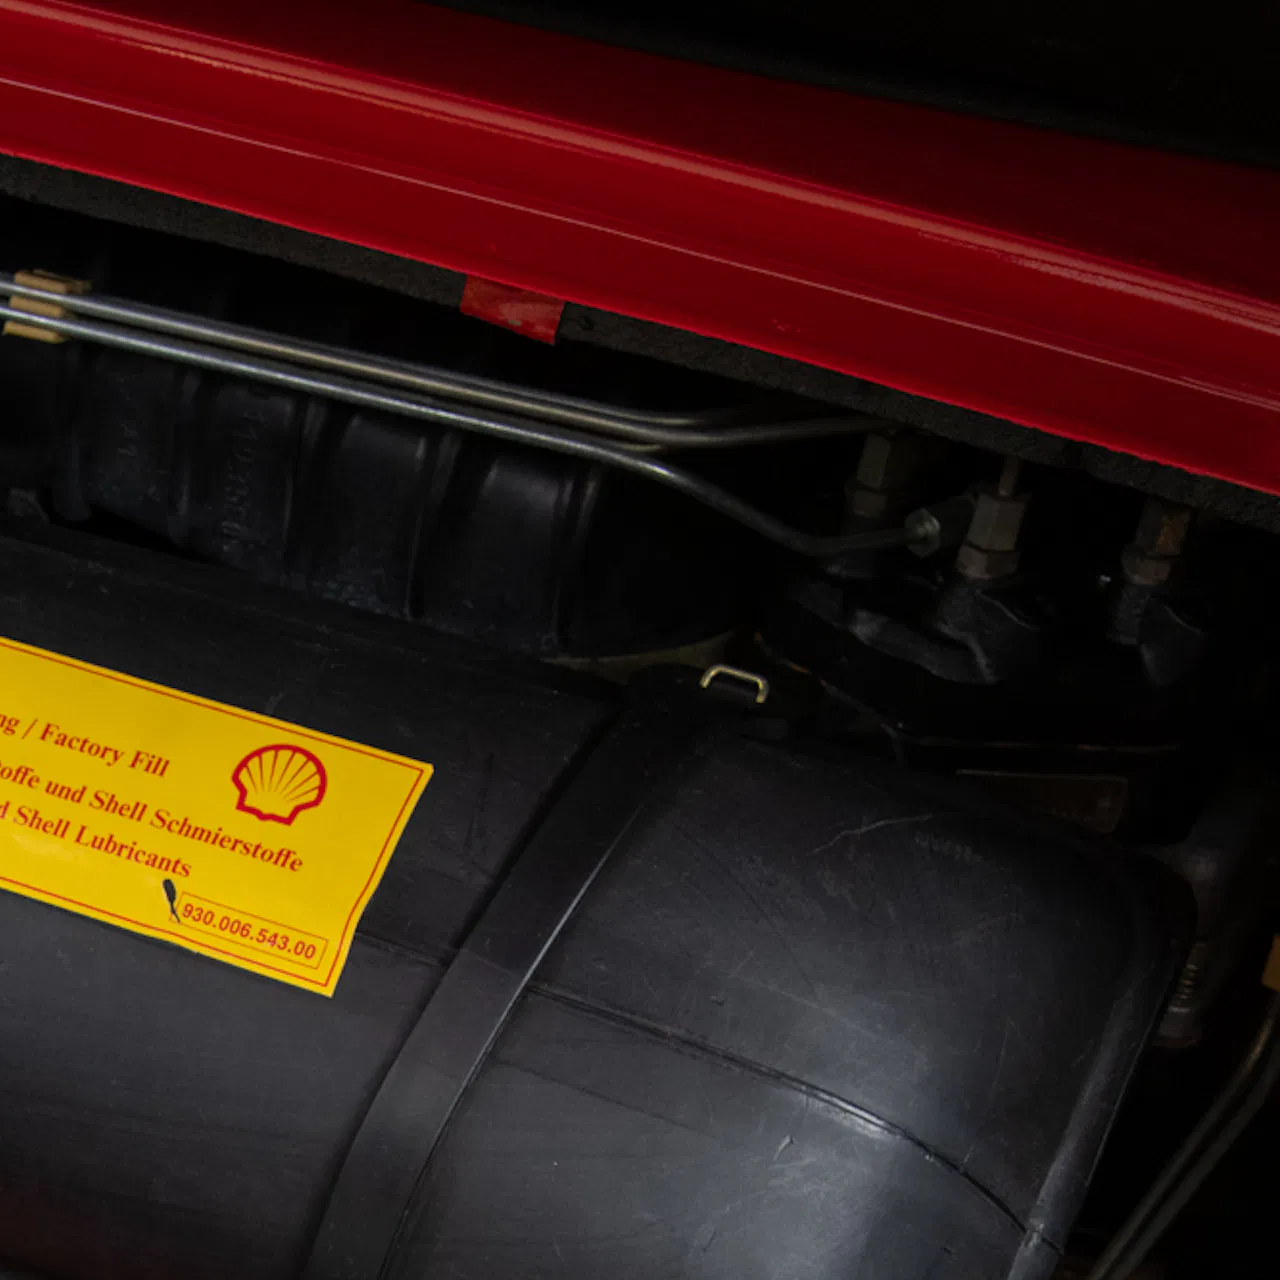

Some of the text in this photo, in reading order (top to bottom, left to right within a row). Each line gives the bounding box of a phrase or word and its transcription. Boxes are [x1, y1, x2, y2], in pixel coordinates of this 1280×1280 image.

[22, 719, 38, 739] /
[40, 723, 124, 766] Factory
[129, 750, 170, 777] Fill
[14, 806, 70, 839] Shell
[74, 825, 191, 877] Lubricants
[45, 781, 87, 803] und
[89, 791, 148, 822] Shell
[150, 809, 303, 872] Schmierstoffe
[181, 903, 317, 961] 930.006.543.00
